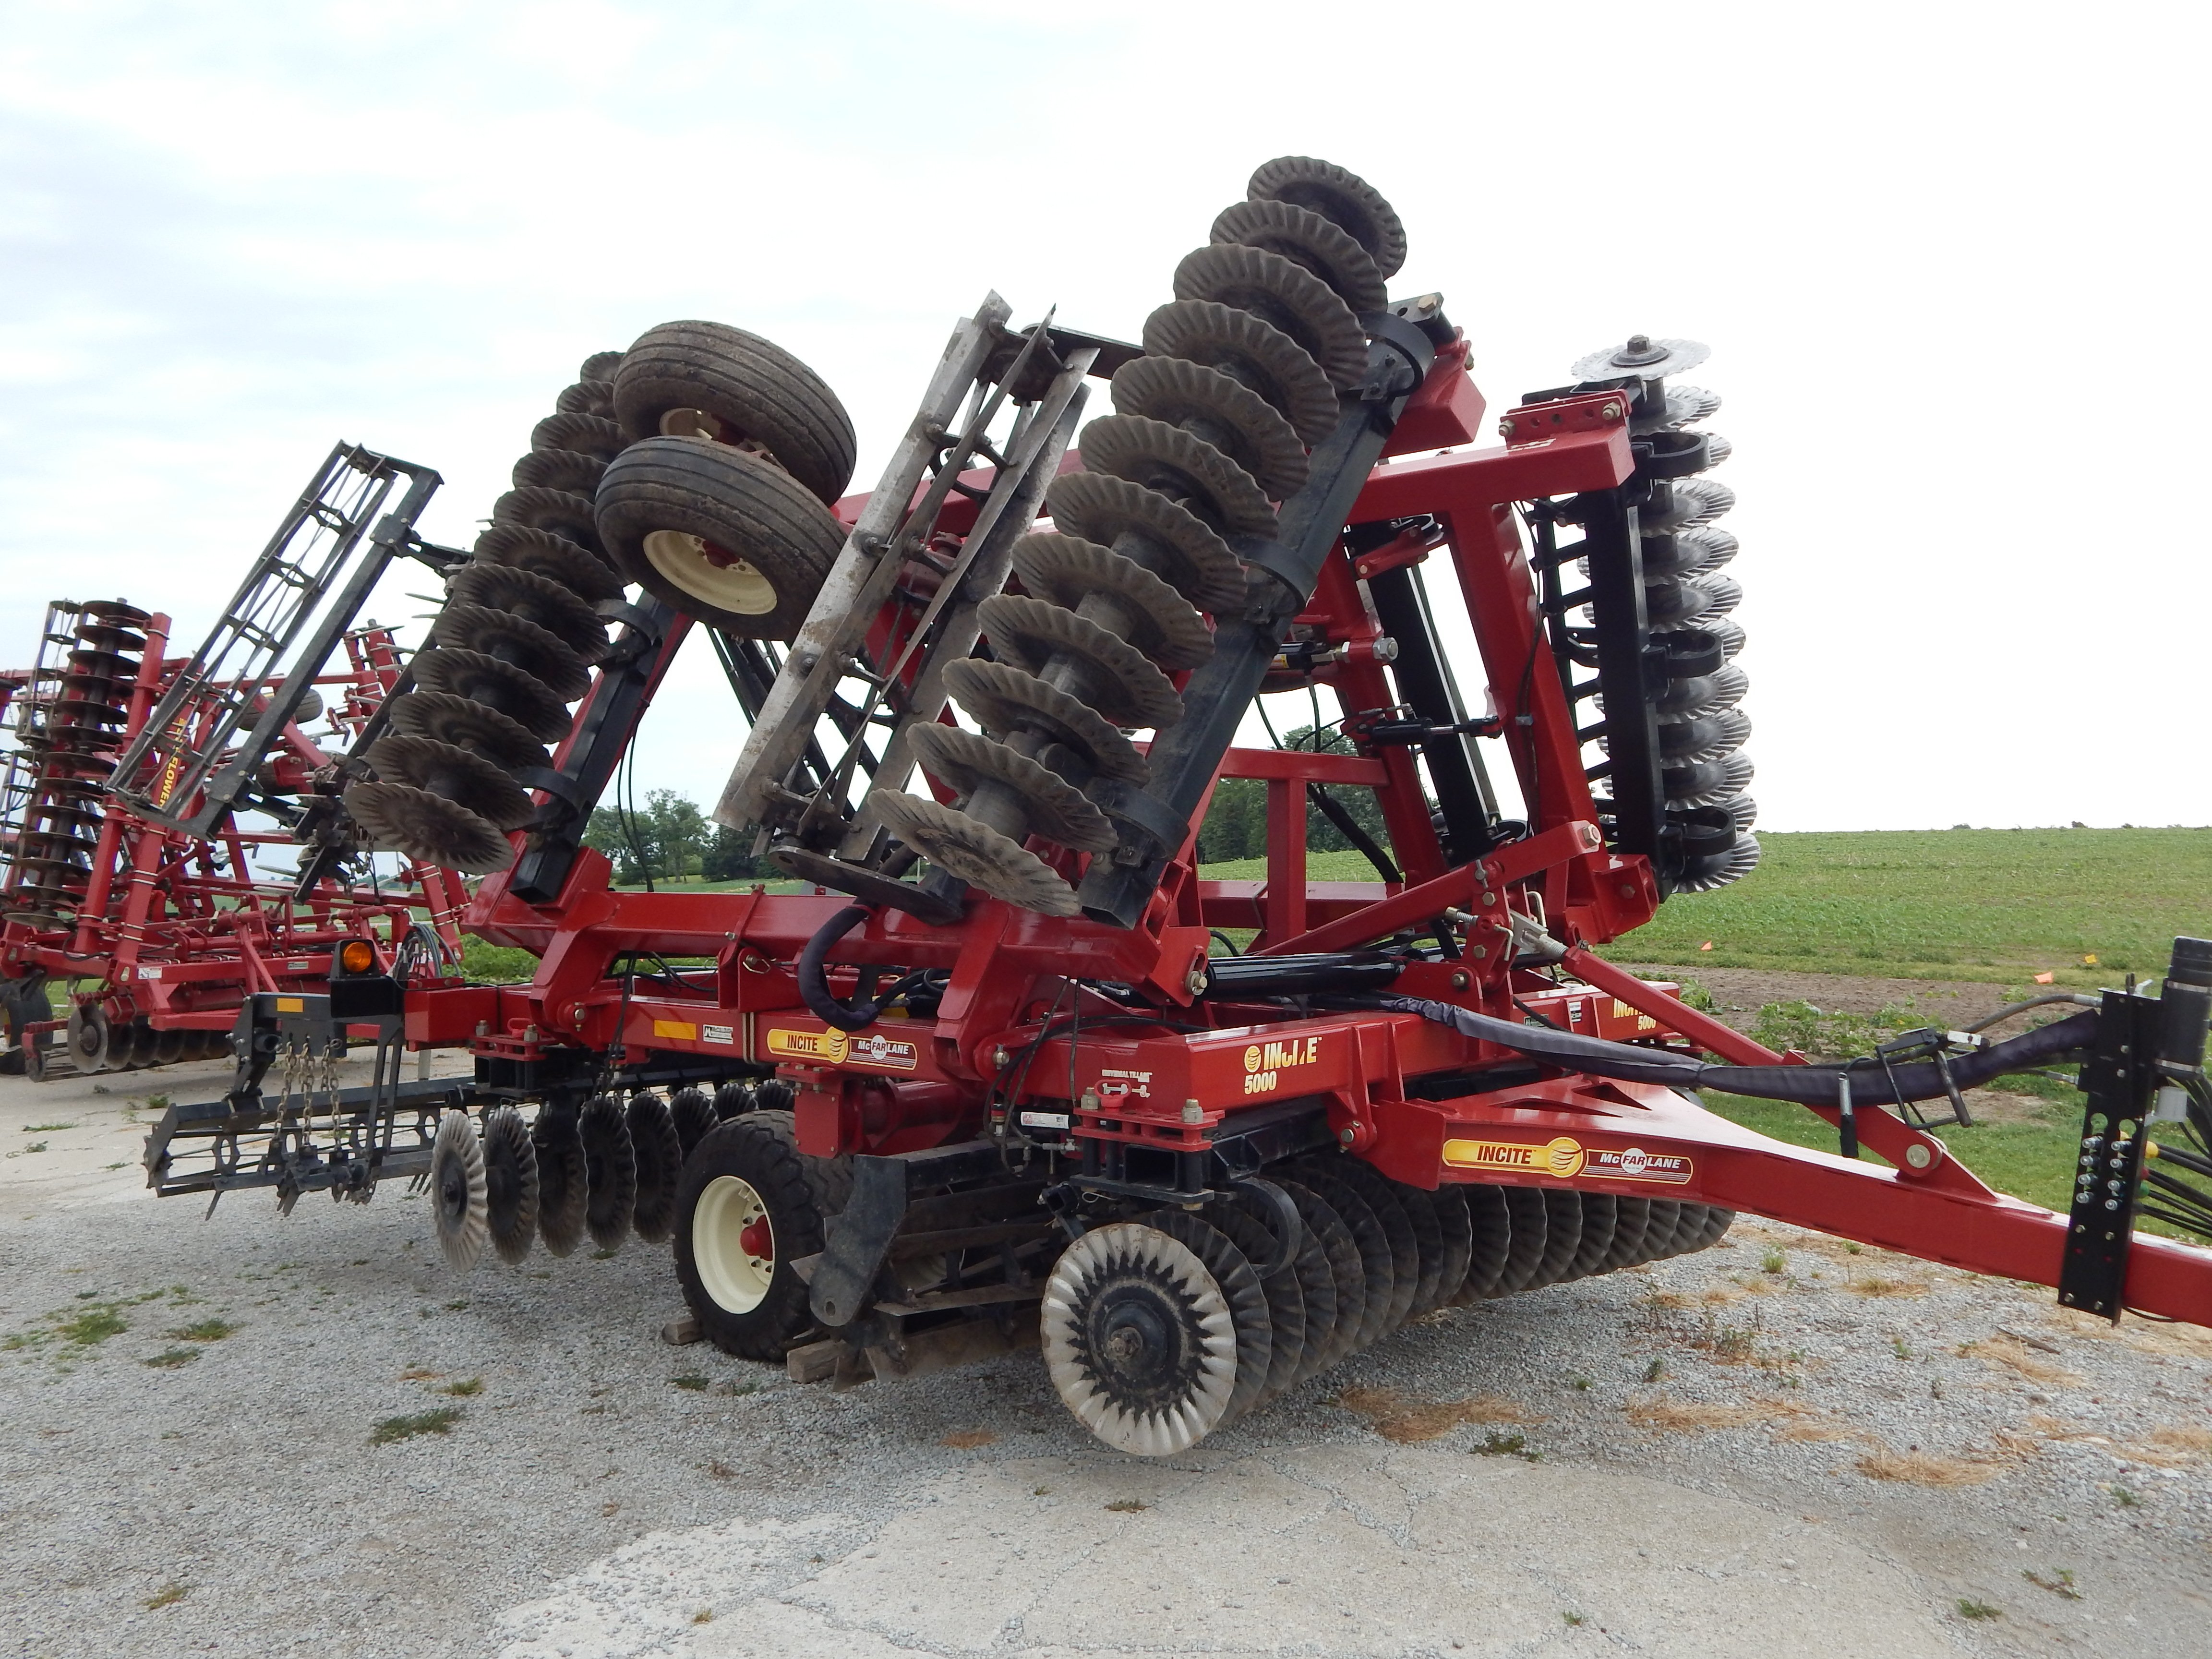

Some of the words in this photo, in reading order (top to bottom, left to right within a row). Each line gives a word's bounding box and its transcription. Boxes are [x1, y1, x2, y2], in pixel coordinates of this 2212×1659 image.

[1638, 1015, 1656, 1031] 5000
[787, 1034, 818, 1051] INCITE
[858, 1040, 909, 1055] McFARLANE
[1244, 1071, 1277, 1094] 5000
[1477, 1145, 1533, 1164] INCITE
[1599, 1153, 1681, 1169] McFARLANE
